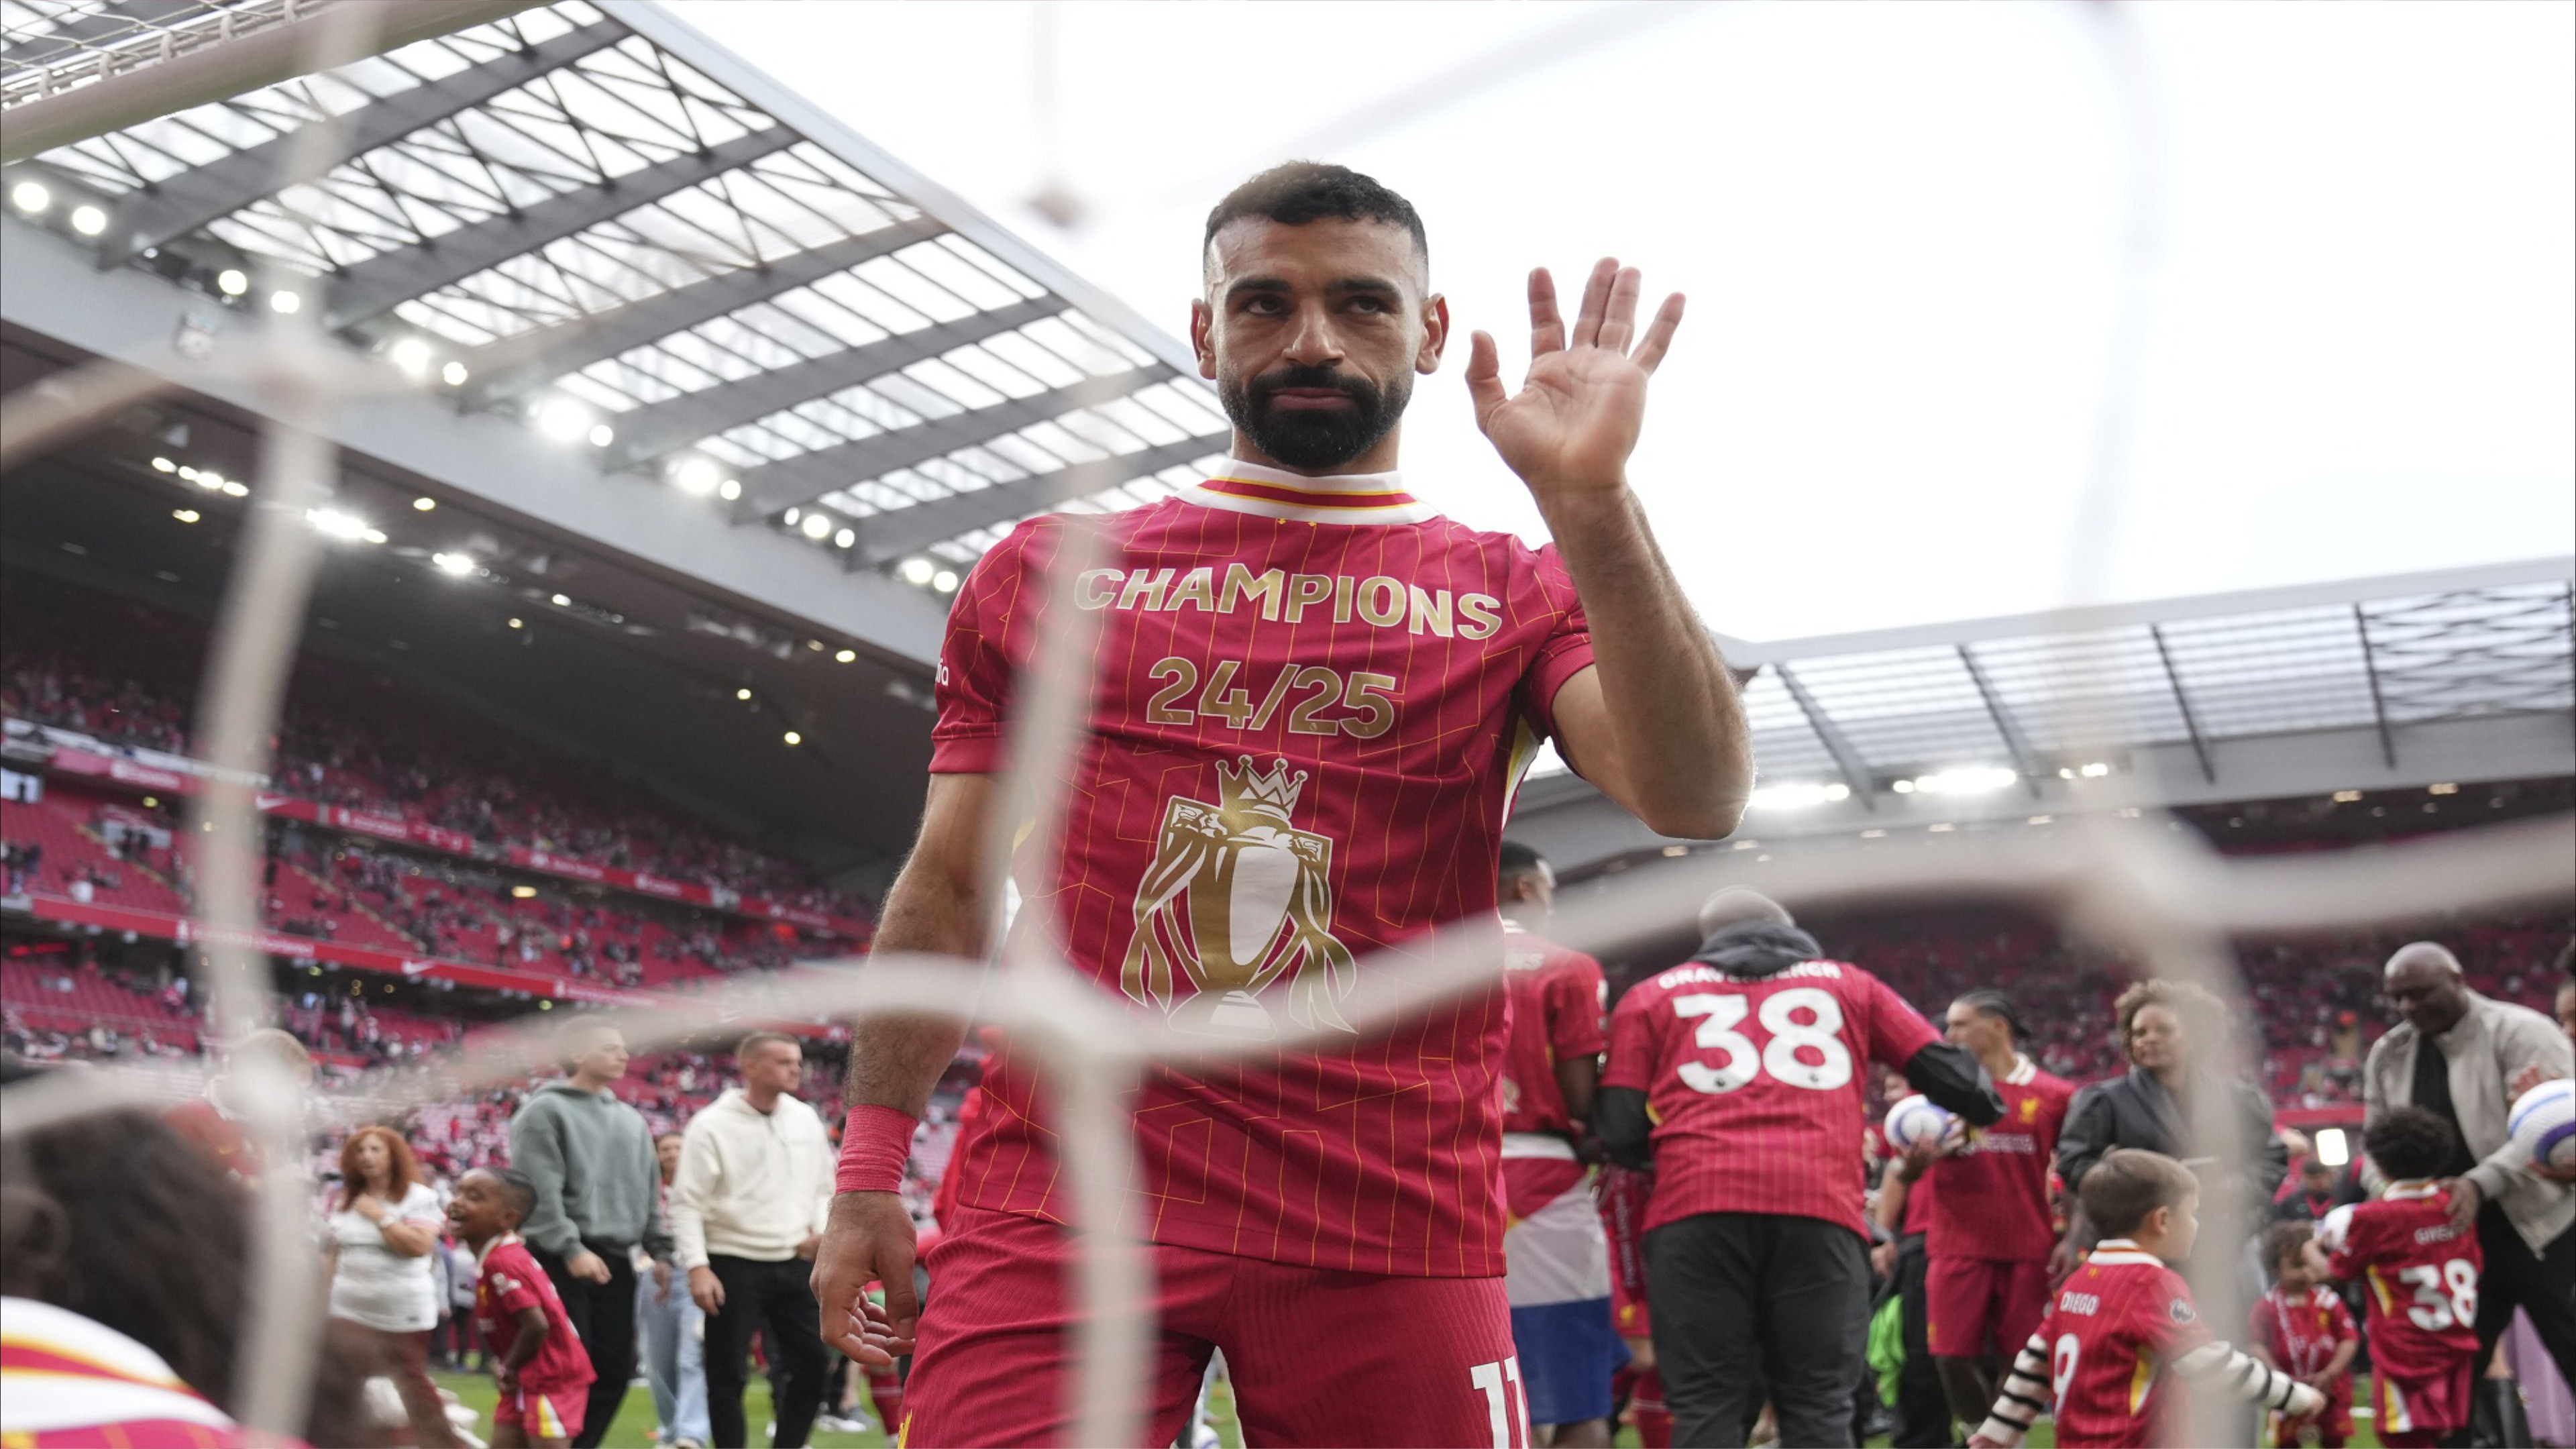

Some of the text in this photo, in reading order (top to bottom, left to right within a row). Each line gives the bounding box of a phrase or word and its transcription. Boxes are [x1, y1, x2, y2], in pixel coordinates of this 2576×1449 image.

[1074, 563, 1502, 640] CHAMPIONS
[1146, 657, 1396, 739] 24/25
[1673, 987, 1853, 1094] 38
[2059, 1291, 2100, 1316] DIEGO
[2399, 1258, 2478, 1332] 38
[1470, 1355, 1529, 1449] 11
[2053, 1333, 2080, 1425] 9
